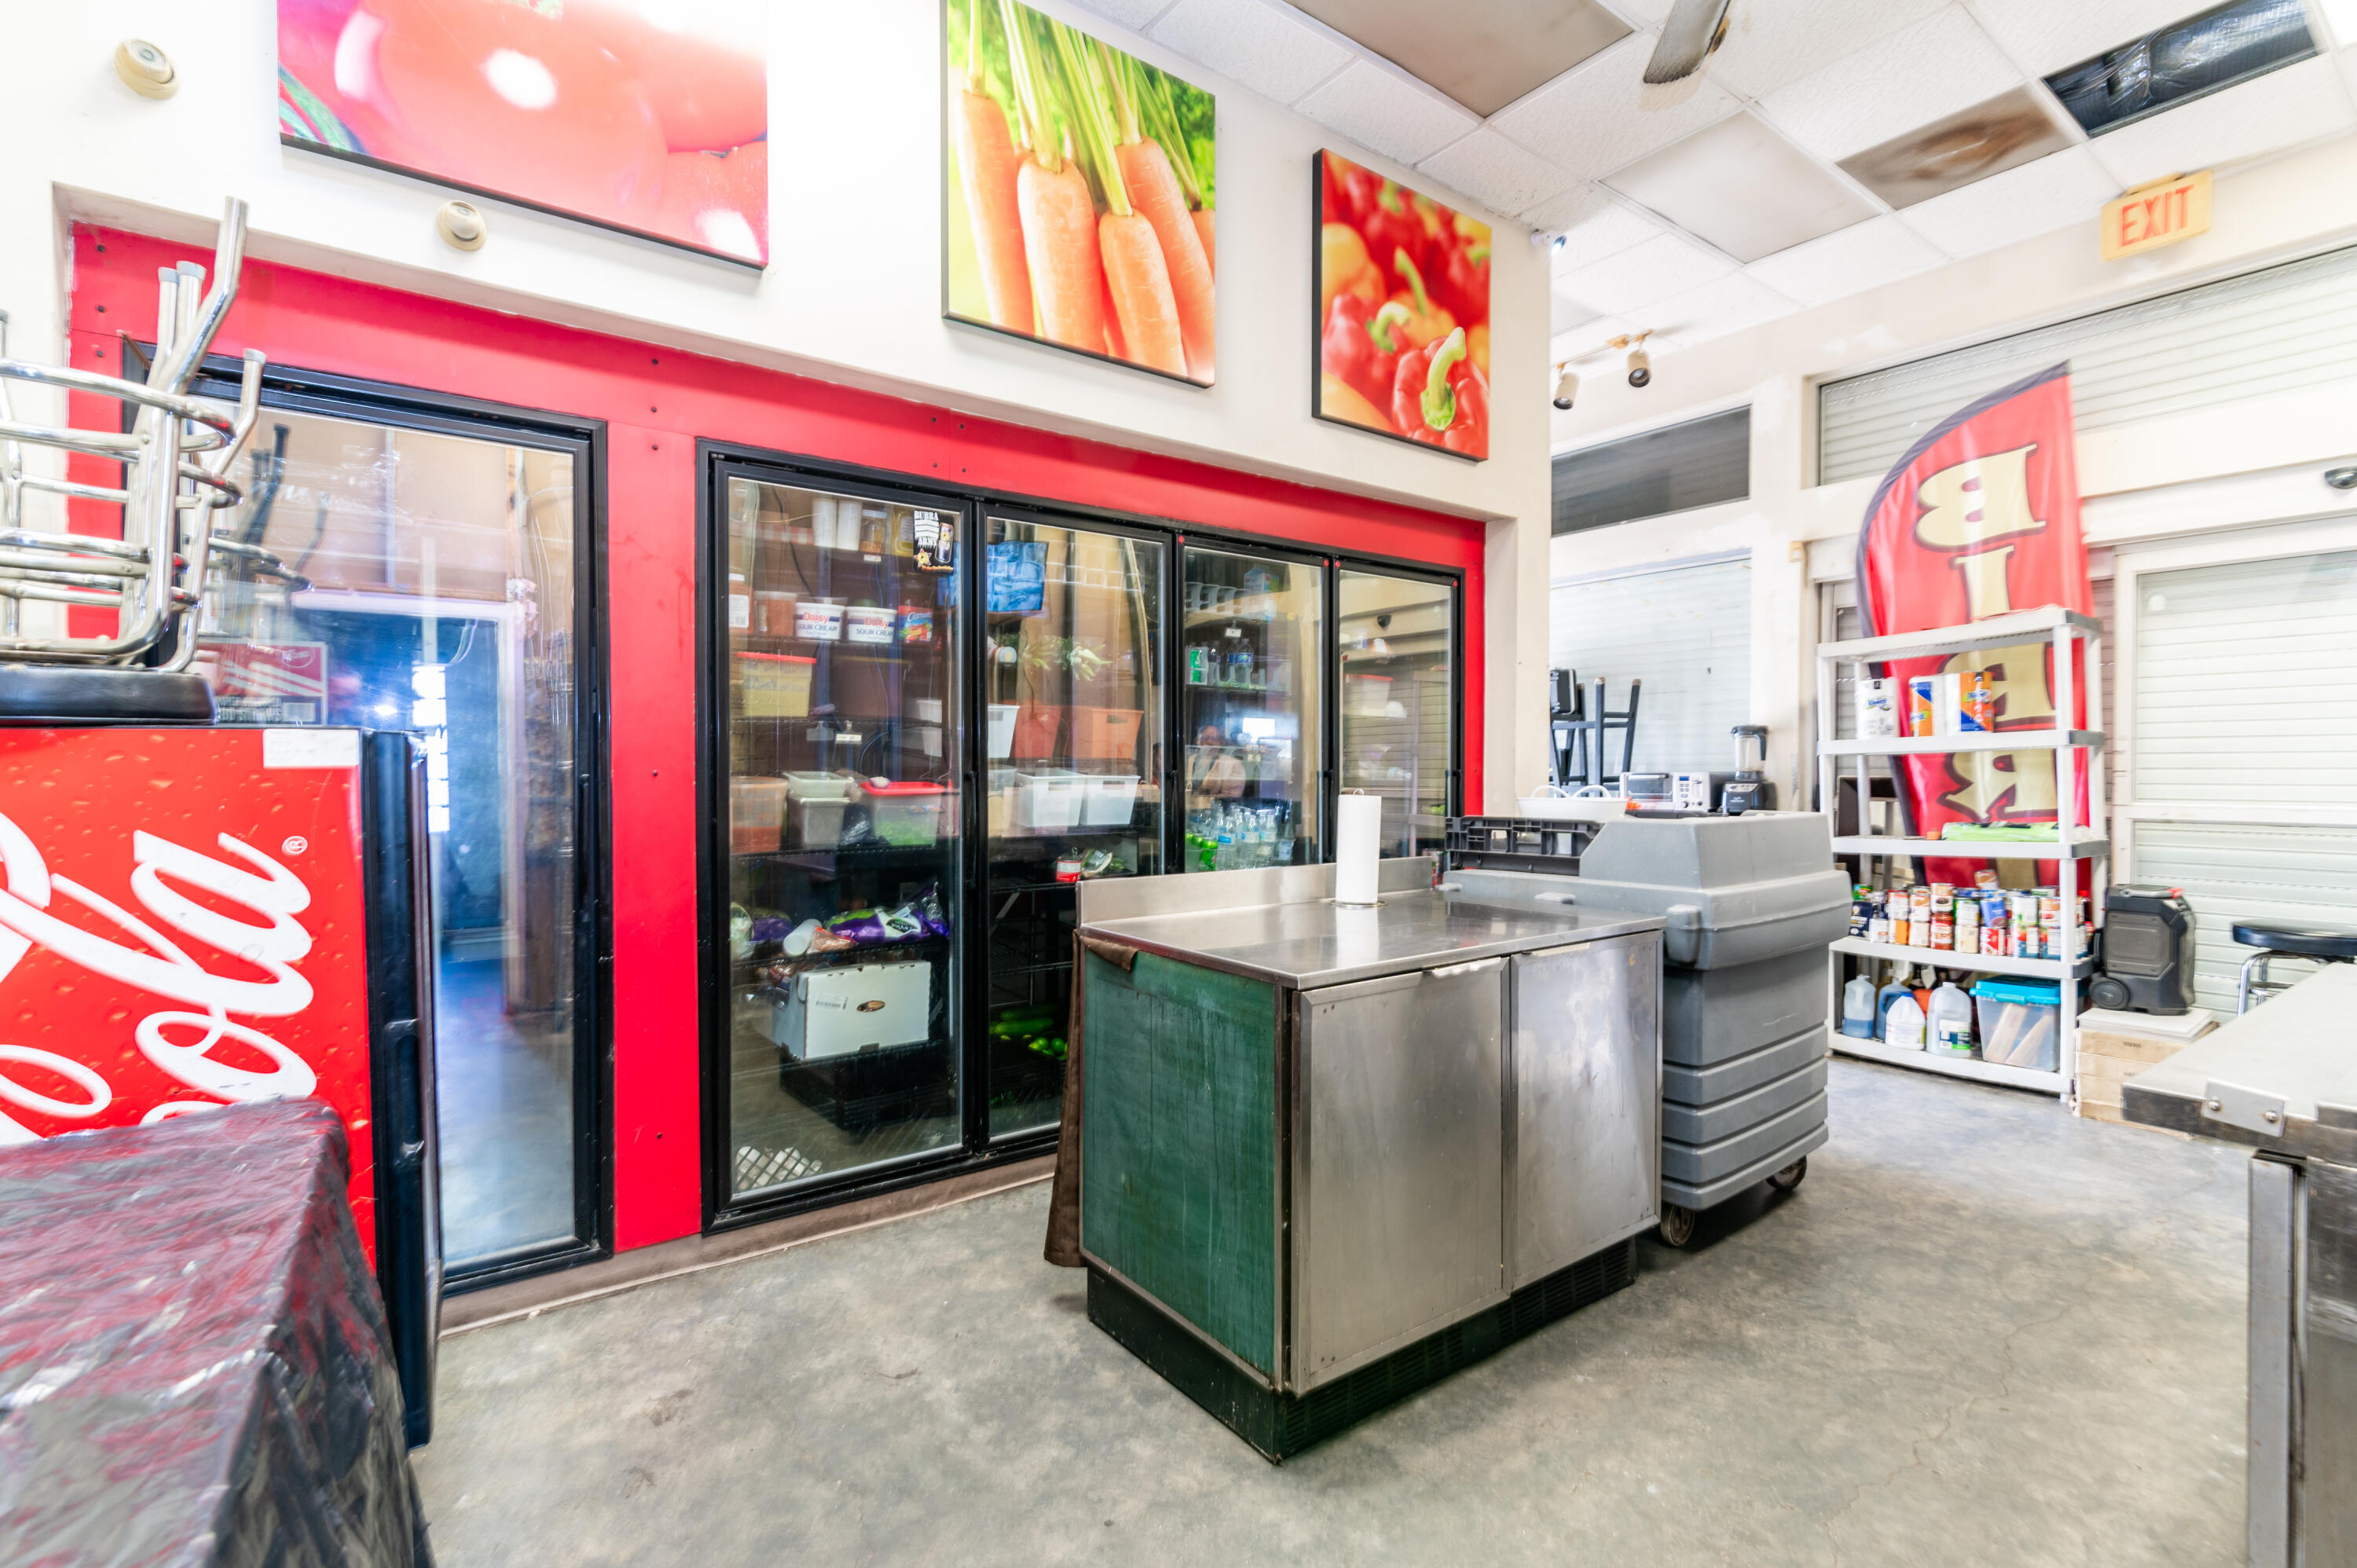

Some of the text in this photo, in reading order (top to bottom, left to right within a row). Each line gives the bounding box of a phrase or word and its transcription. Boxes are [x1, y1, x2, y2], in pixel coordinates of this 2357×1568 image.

[2120, 184, 2194, 247] EXIT
[802, 612, 830, 623] Daisy
[865, 616, 889, 628] Daisy
[0, 811, 317, 1136] ola
